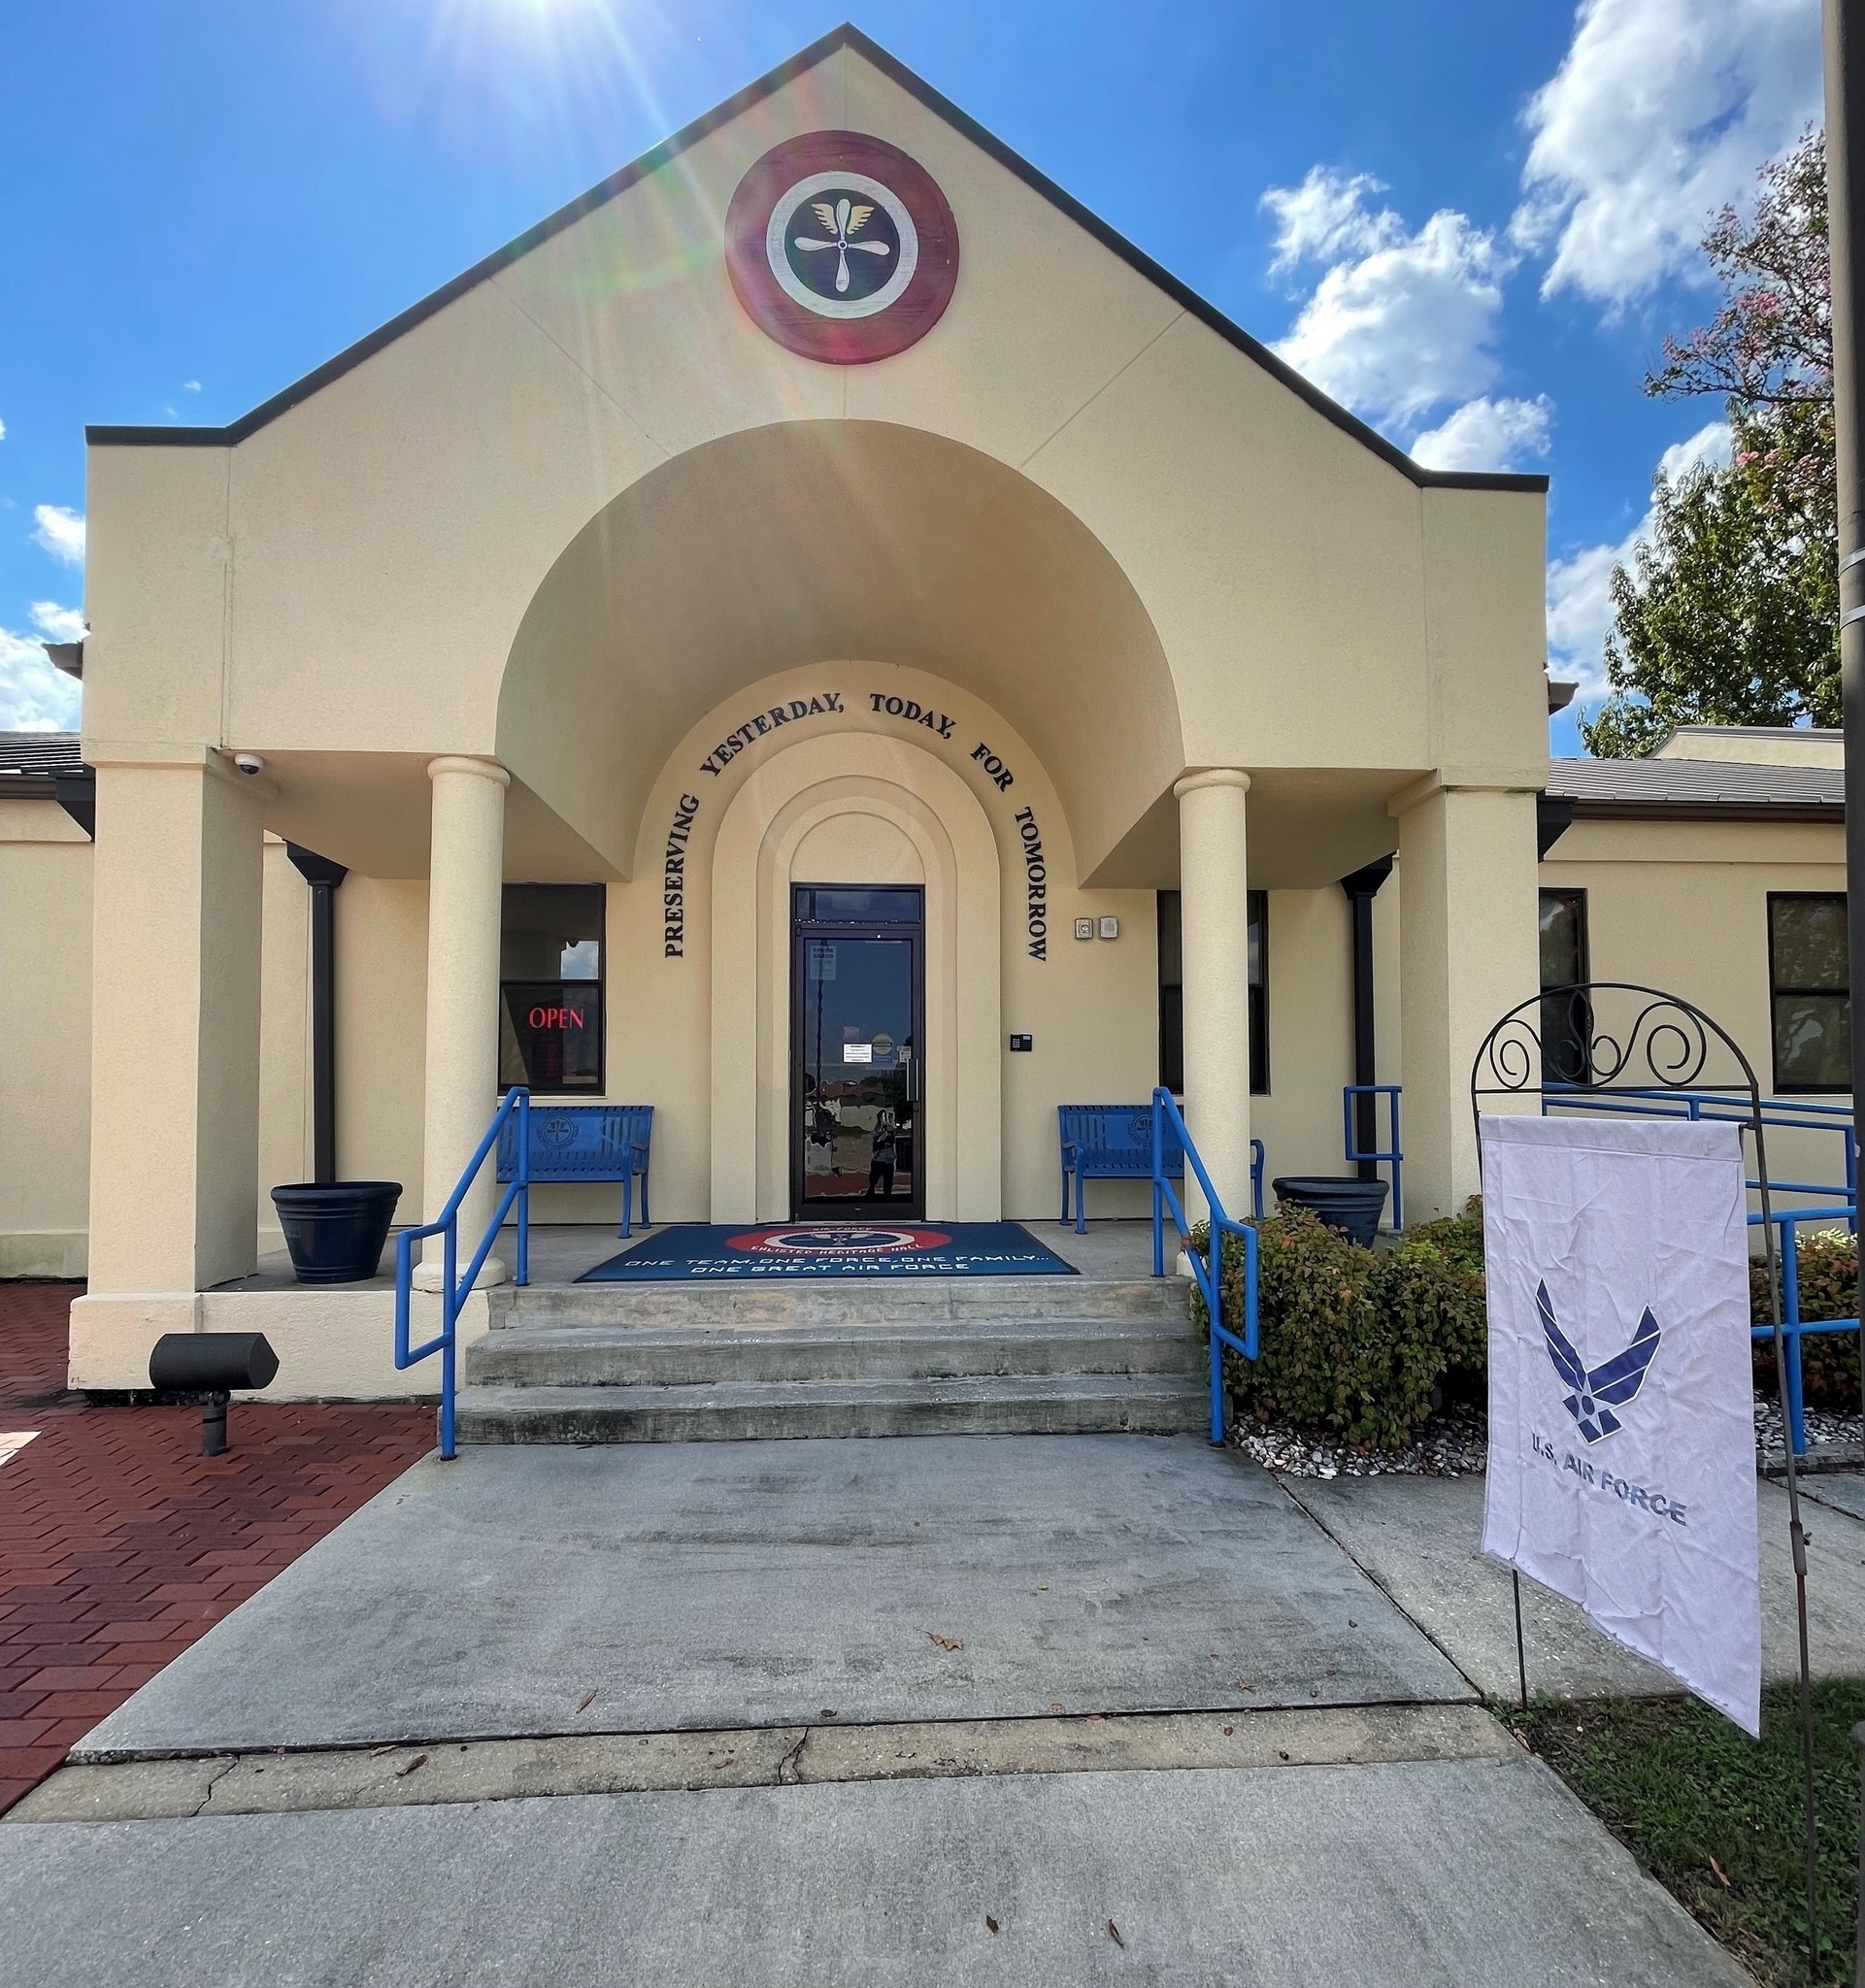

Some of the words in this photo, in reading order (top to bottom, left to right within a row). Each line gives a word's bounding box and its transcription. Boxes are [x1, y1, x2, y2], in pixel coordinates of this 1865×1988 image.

[664, 792, 700, 958] PRESERVING
[699, 692, 845, 778] YESTERDAY,
[869, 693, 956, 740] TODAY,
[970, 742, 1014, 793] FOR
[1014, 806, 1047, 962] TOMORROW
[529, 1007, 584, 1029] OPEN
[750, 1244, 813, 1254] ENLISTED
[891, 1242, 923, 1252] HALL
[750, 1264, 832, 1273] GREAT
[1532, 1433, 1557, 1466] U.S.
[1563, 1453, 1595, 1485] AIR
[1601, 1471, 1687, 1527] FORCE
